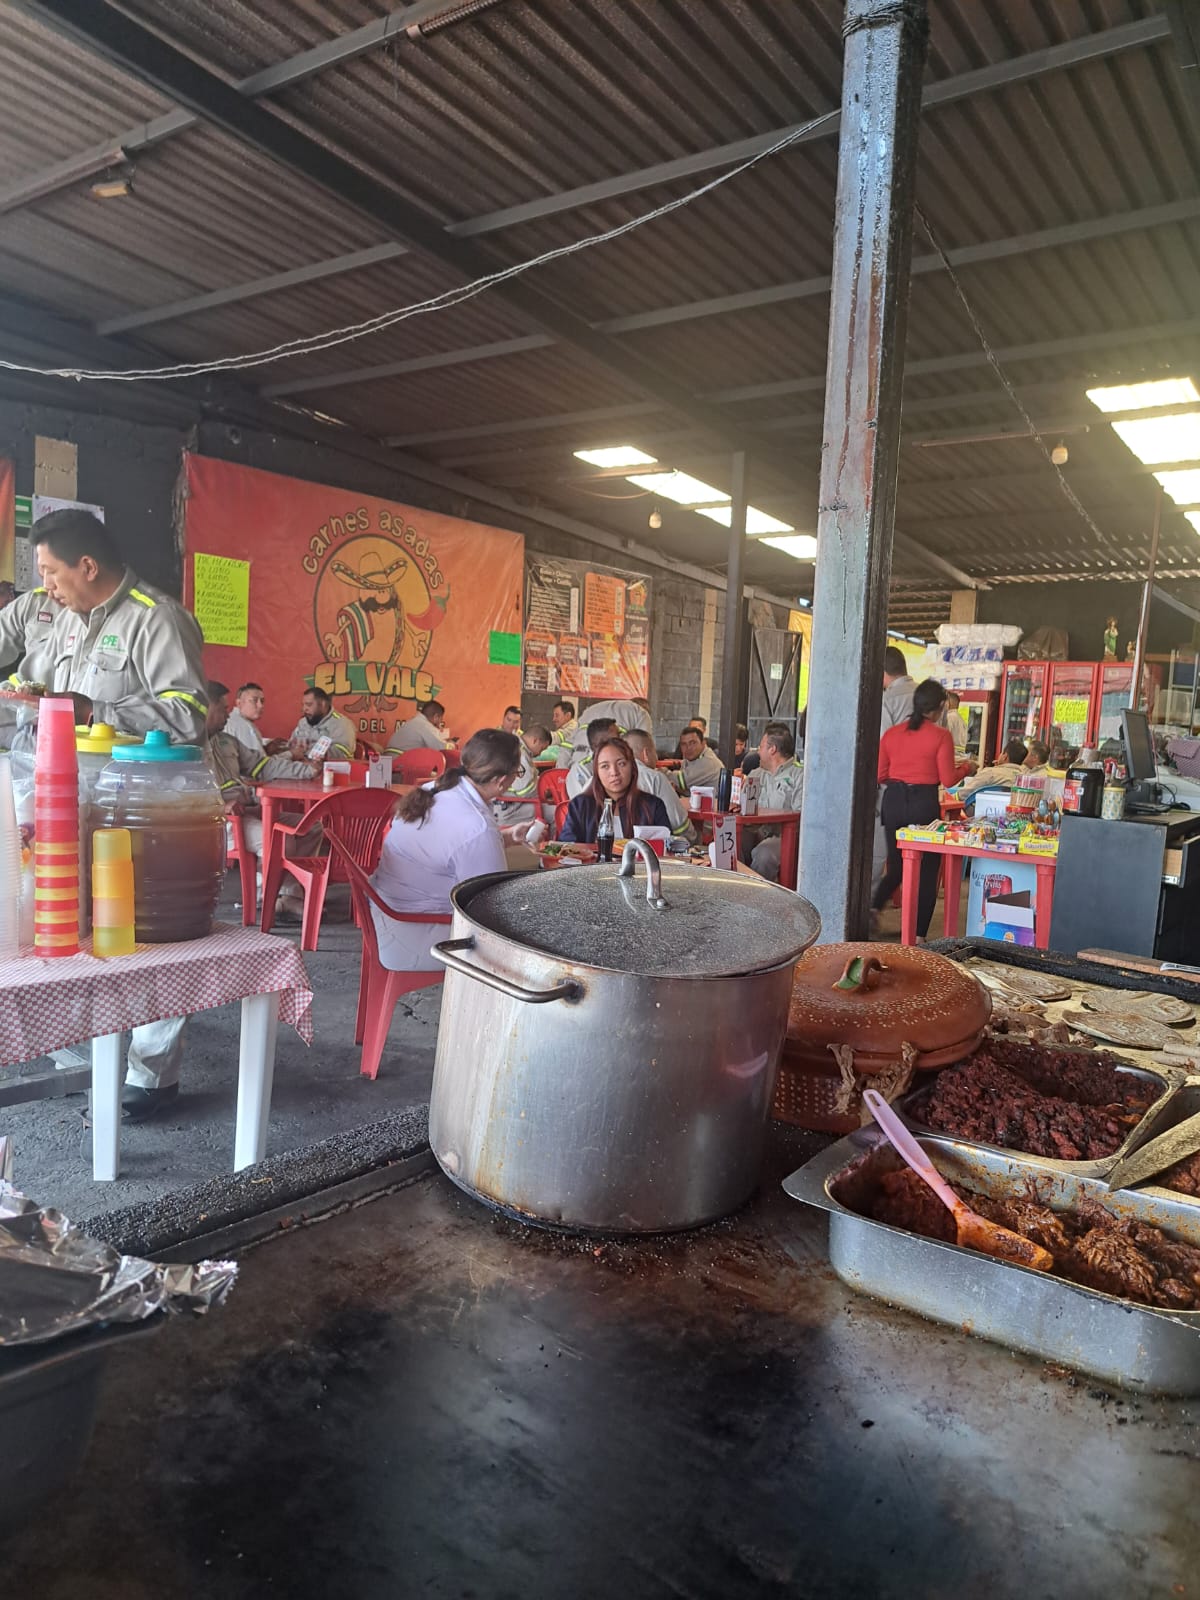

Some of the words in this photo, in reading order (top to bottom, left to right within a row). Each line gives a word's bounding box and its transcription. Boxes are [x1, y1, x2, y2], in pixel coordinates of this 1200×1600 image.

[302, 507, 370, 575] carnes
[378, 510, 445, 590] asadas
[314, 661, 352, 695] EL
[365, 661, 434, 702] VALE
[359, 719, 387, 733] DEL
[720, 832, 734, 853] 13
